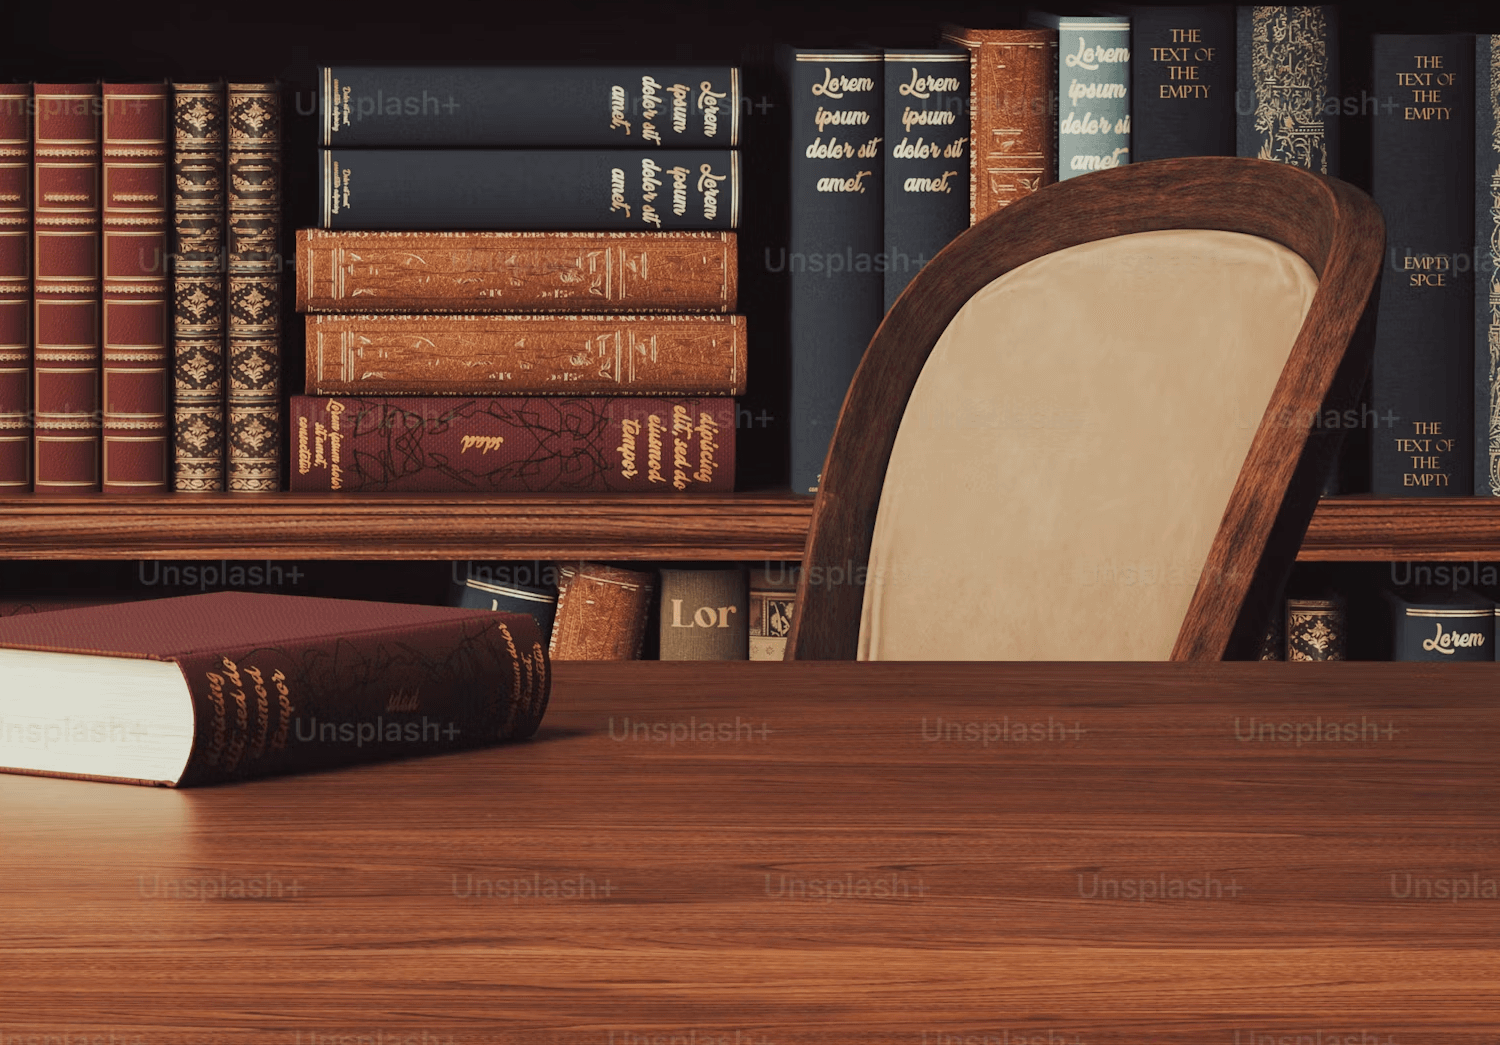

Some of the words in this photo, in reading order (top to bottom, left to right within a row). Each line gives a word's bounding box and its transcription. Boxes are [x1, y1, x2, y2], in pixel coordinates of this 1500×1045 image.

[1170, 29, 1201, 42] THE
[1065, 37, 1128, 70] Lorem
[1151, 48, 1189, 61] TEXT
[1195, 48, 1214, 61] OF
[812, 68, 874, 98] Lorem
[1168, 66, 1198, 79] THE
[642, 76, 662, 119] dolor
[1068, 79, 1126, 105] ipsum
[1160, 85, 1207, 98] EMPTY
[610, 86, 631, 134] amet,
[670, 84, 688, 133] ipsum
[698, 82, 726, 137] Lorem
[815, 107, 869, 130] ipsum
[642, 118, 661, 145] sit
[1061, 112, 1111, 134] dolor
[806, 137, 854, 159] dolor
[858, 137, 882, 158] sit
[817, 171, 871, 193] amet,
[669, 599, 736, 635] Lor
[1423, 623, 1484, 654] Lorem
